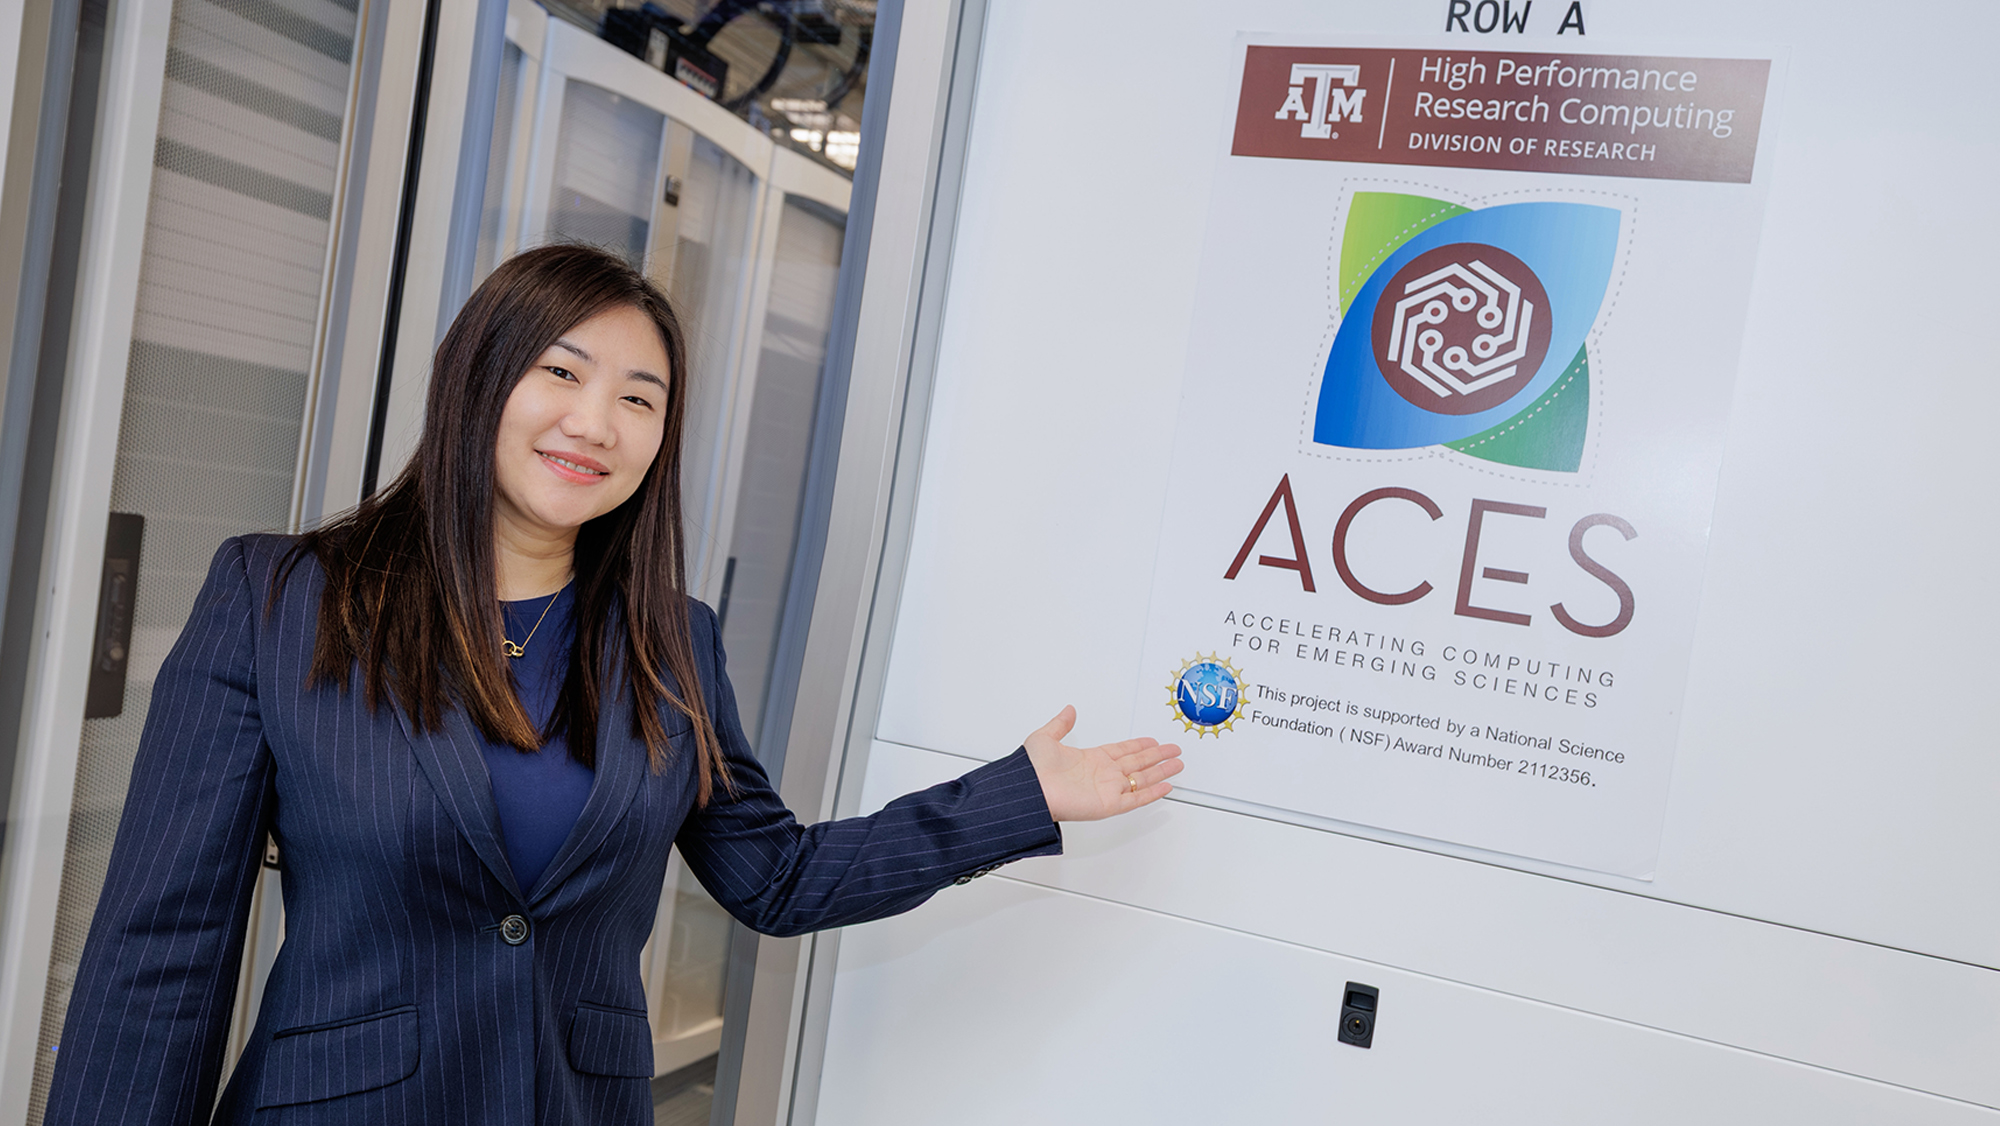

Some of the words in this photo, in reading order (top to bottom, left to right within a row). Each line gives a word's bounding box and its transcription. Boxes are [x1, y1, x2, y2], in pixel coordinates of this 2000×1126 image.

[1445, 0, 1532, 35] ROW
[1556, 0, 1586, 36] A
[1419, 56, 1486, 91] High
[1496, 59, 1697, 92] Performance
[1414, 92, 1549, 123] Research
[1559, 98, 1735, 139] Computing
[1408, 132, 1502, 154] DIVISION
[1509, 137, 1538, 156] OF
[1544, 139, 1656, 161] RESEARCH
[1223, 472, 1638, 638] ACES
[1224, 610, 1426, 656] ACCELERATING
[1442, 645, 1615, 688] COMPUTING
[1232, 633, 1280, 653] FOR
[1296, 643, 1437, 681] EMERGING
[1453, 670, 1598, 708] SCIENCES
[1178, 678, 1238, 710] NSF
[1256, 684, 1287, 702] This
[1290, 693, 1341, 713] project
[1345, 700, 1358, 716] is
[1363, 708, 1441, 730] supported
[1446, 718, 1466, 738] by
[1469, 727, 1480, 738] a
[1486, 725, 1552, 751] National
[1558, 738, 1625, 764] Science
[1251, 710, 1333, 738] Foundation
[1448, 746, 1513, 772] Number
[1517, 759, 1597, 788] 2112356.
